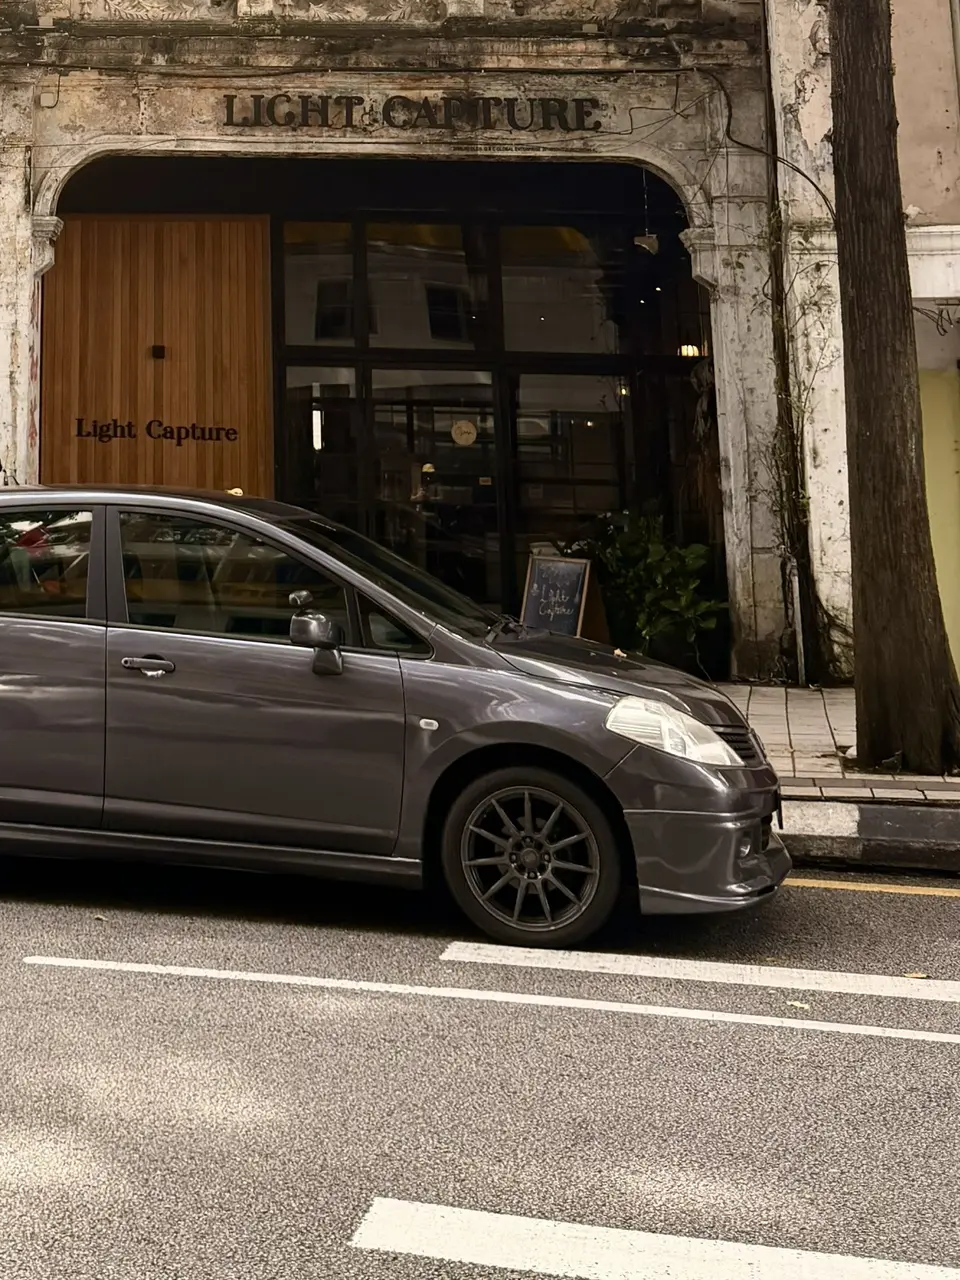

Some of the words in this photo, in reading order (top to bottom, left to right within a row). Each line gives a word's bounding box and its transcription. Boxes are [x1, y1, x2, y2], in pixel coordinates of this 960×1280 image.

[223, 94, 364, 128] LIGHT
[382, 95, 602, 131] CAPTURE
[75, 418, 136, 443] Light
[145, 419, 238, 447] Capture
